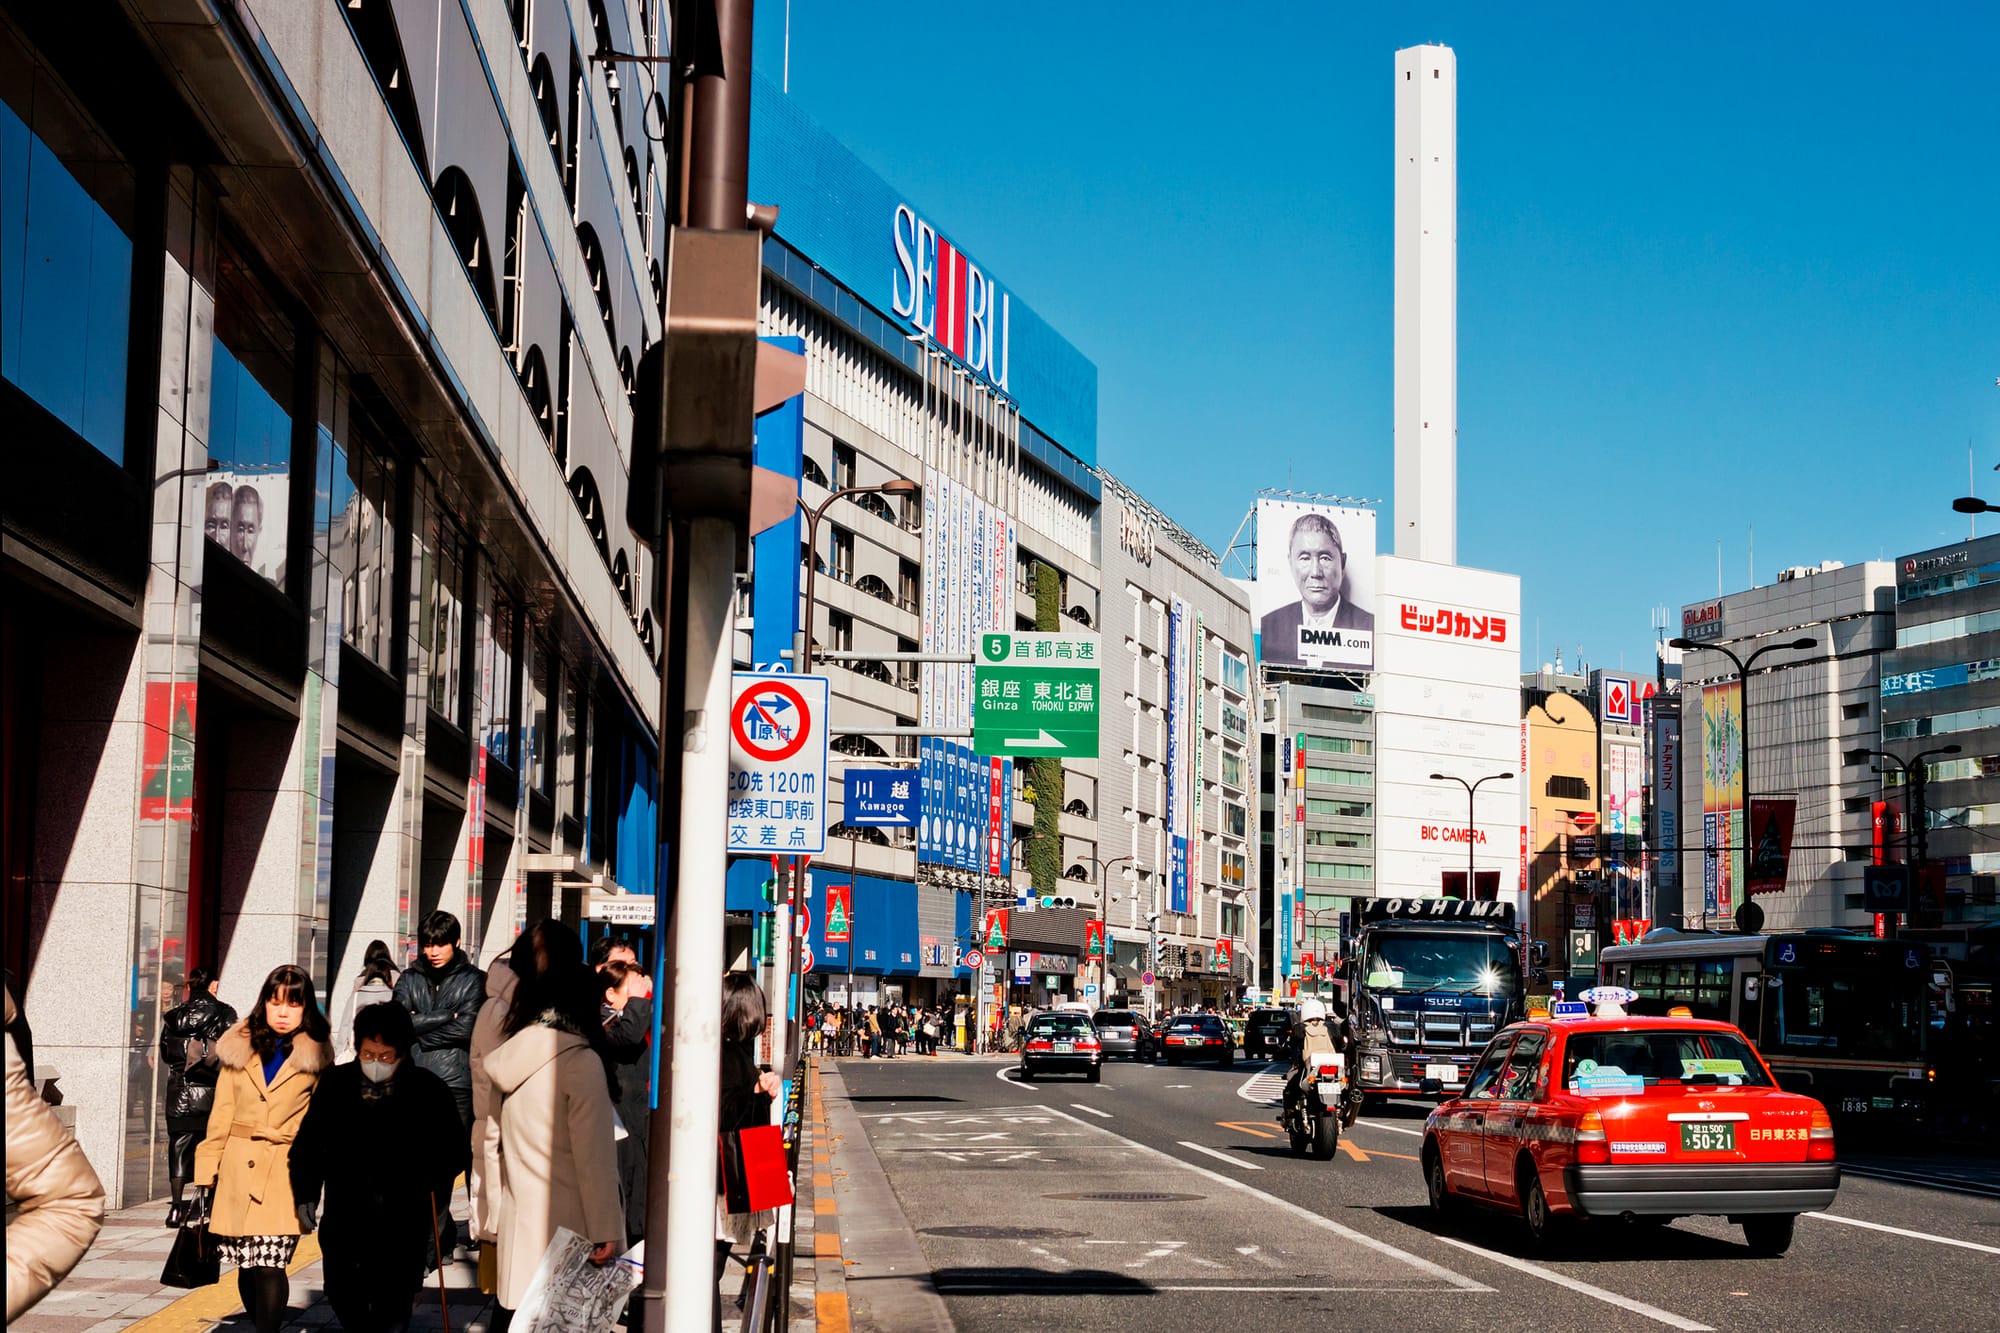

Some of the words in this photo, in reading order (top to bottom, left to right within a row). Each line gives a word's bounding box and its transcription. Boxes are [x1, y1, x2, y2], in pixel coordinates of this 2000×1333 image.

[892, 203, 1010, 395] SEIBU
[1401, 603, 1506, 643] ビックカメラ
[991, 639, 1002, 655] 5
[1301, 629, 1370, 649] DMM.com
[1014, 640, 1094, 660] 首都高速
[981, 679, 1021, 698] 銀座
[1033, 681, 1093, 701] 東北道
[982, 700, 1018, 711] Ginza
[1032, 700, 1064, 712] TOHOKU
[1068, 701, 1095, 712] EXPWY
[758, 723, 792, 741] 原付
[729, 771, 763, 792] この先
[769, 771, 815, 794] 120m
[855, 780, 910, 799] 川越
[860, 800, 904, 814] Kawagoe
[730, 824, 806, 846] 交差点
[1421, 825, 1439, 841] BIC
[1442, 827, 1487, 845] CAMERA
[1660, 810, 1674, 867] ADERANS
[1365, 897, 1505, 917] TOSHIMA
[1018, 955, 1028, 967] P
[1085, 985, 1097, 997] P
[1597, 991, 1624, 1001] チェッカー
[1424, 998, 1462, 1007] ISUZU
[1692, 1133, 1731, 1149] 50-21
[1750, 1128, 1809, 1141] 日月東交通
